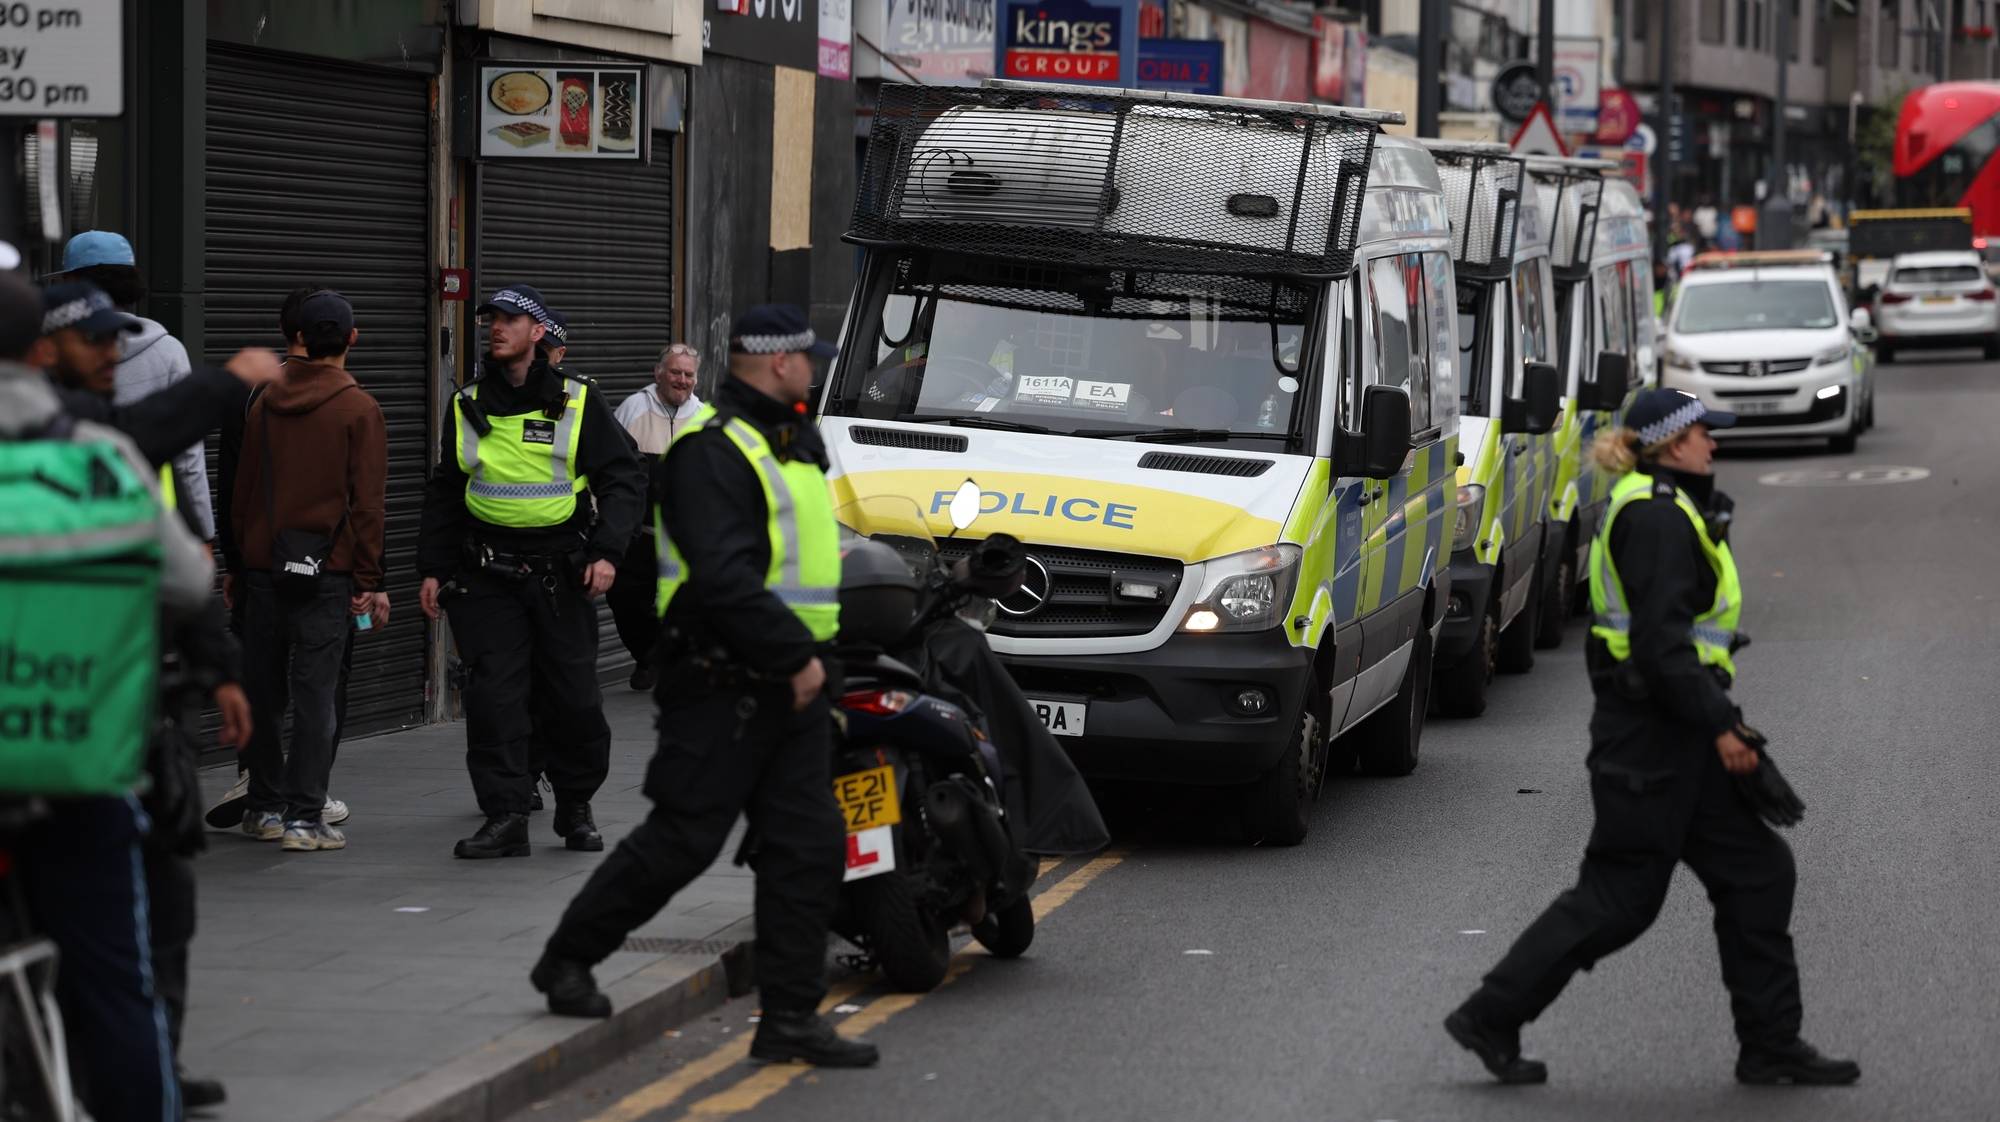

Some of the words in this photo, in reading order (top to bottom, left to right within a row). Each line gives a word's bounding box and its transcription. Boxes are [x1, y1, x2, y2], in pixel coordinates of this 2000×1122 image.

[37, 9, 82, 32] pm
[1017, 9, 1112, 52] kings
[1015, 57, 1109, 74] GROUP
[44, 84, 88, 108] pm
[1024, 377, 1071, 390] 1611A
[1089, 385, 1116, 398] EA
[833, 772, 887, 803] E21
[839, 798, 885, 826] ZF
